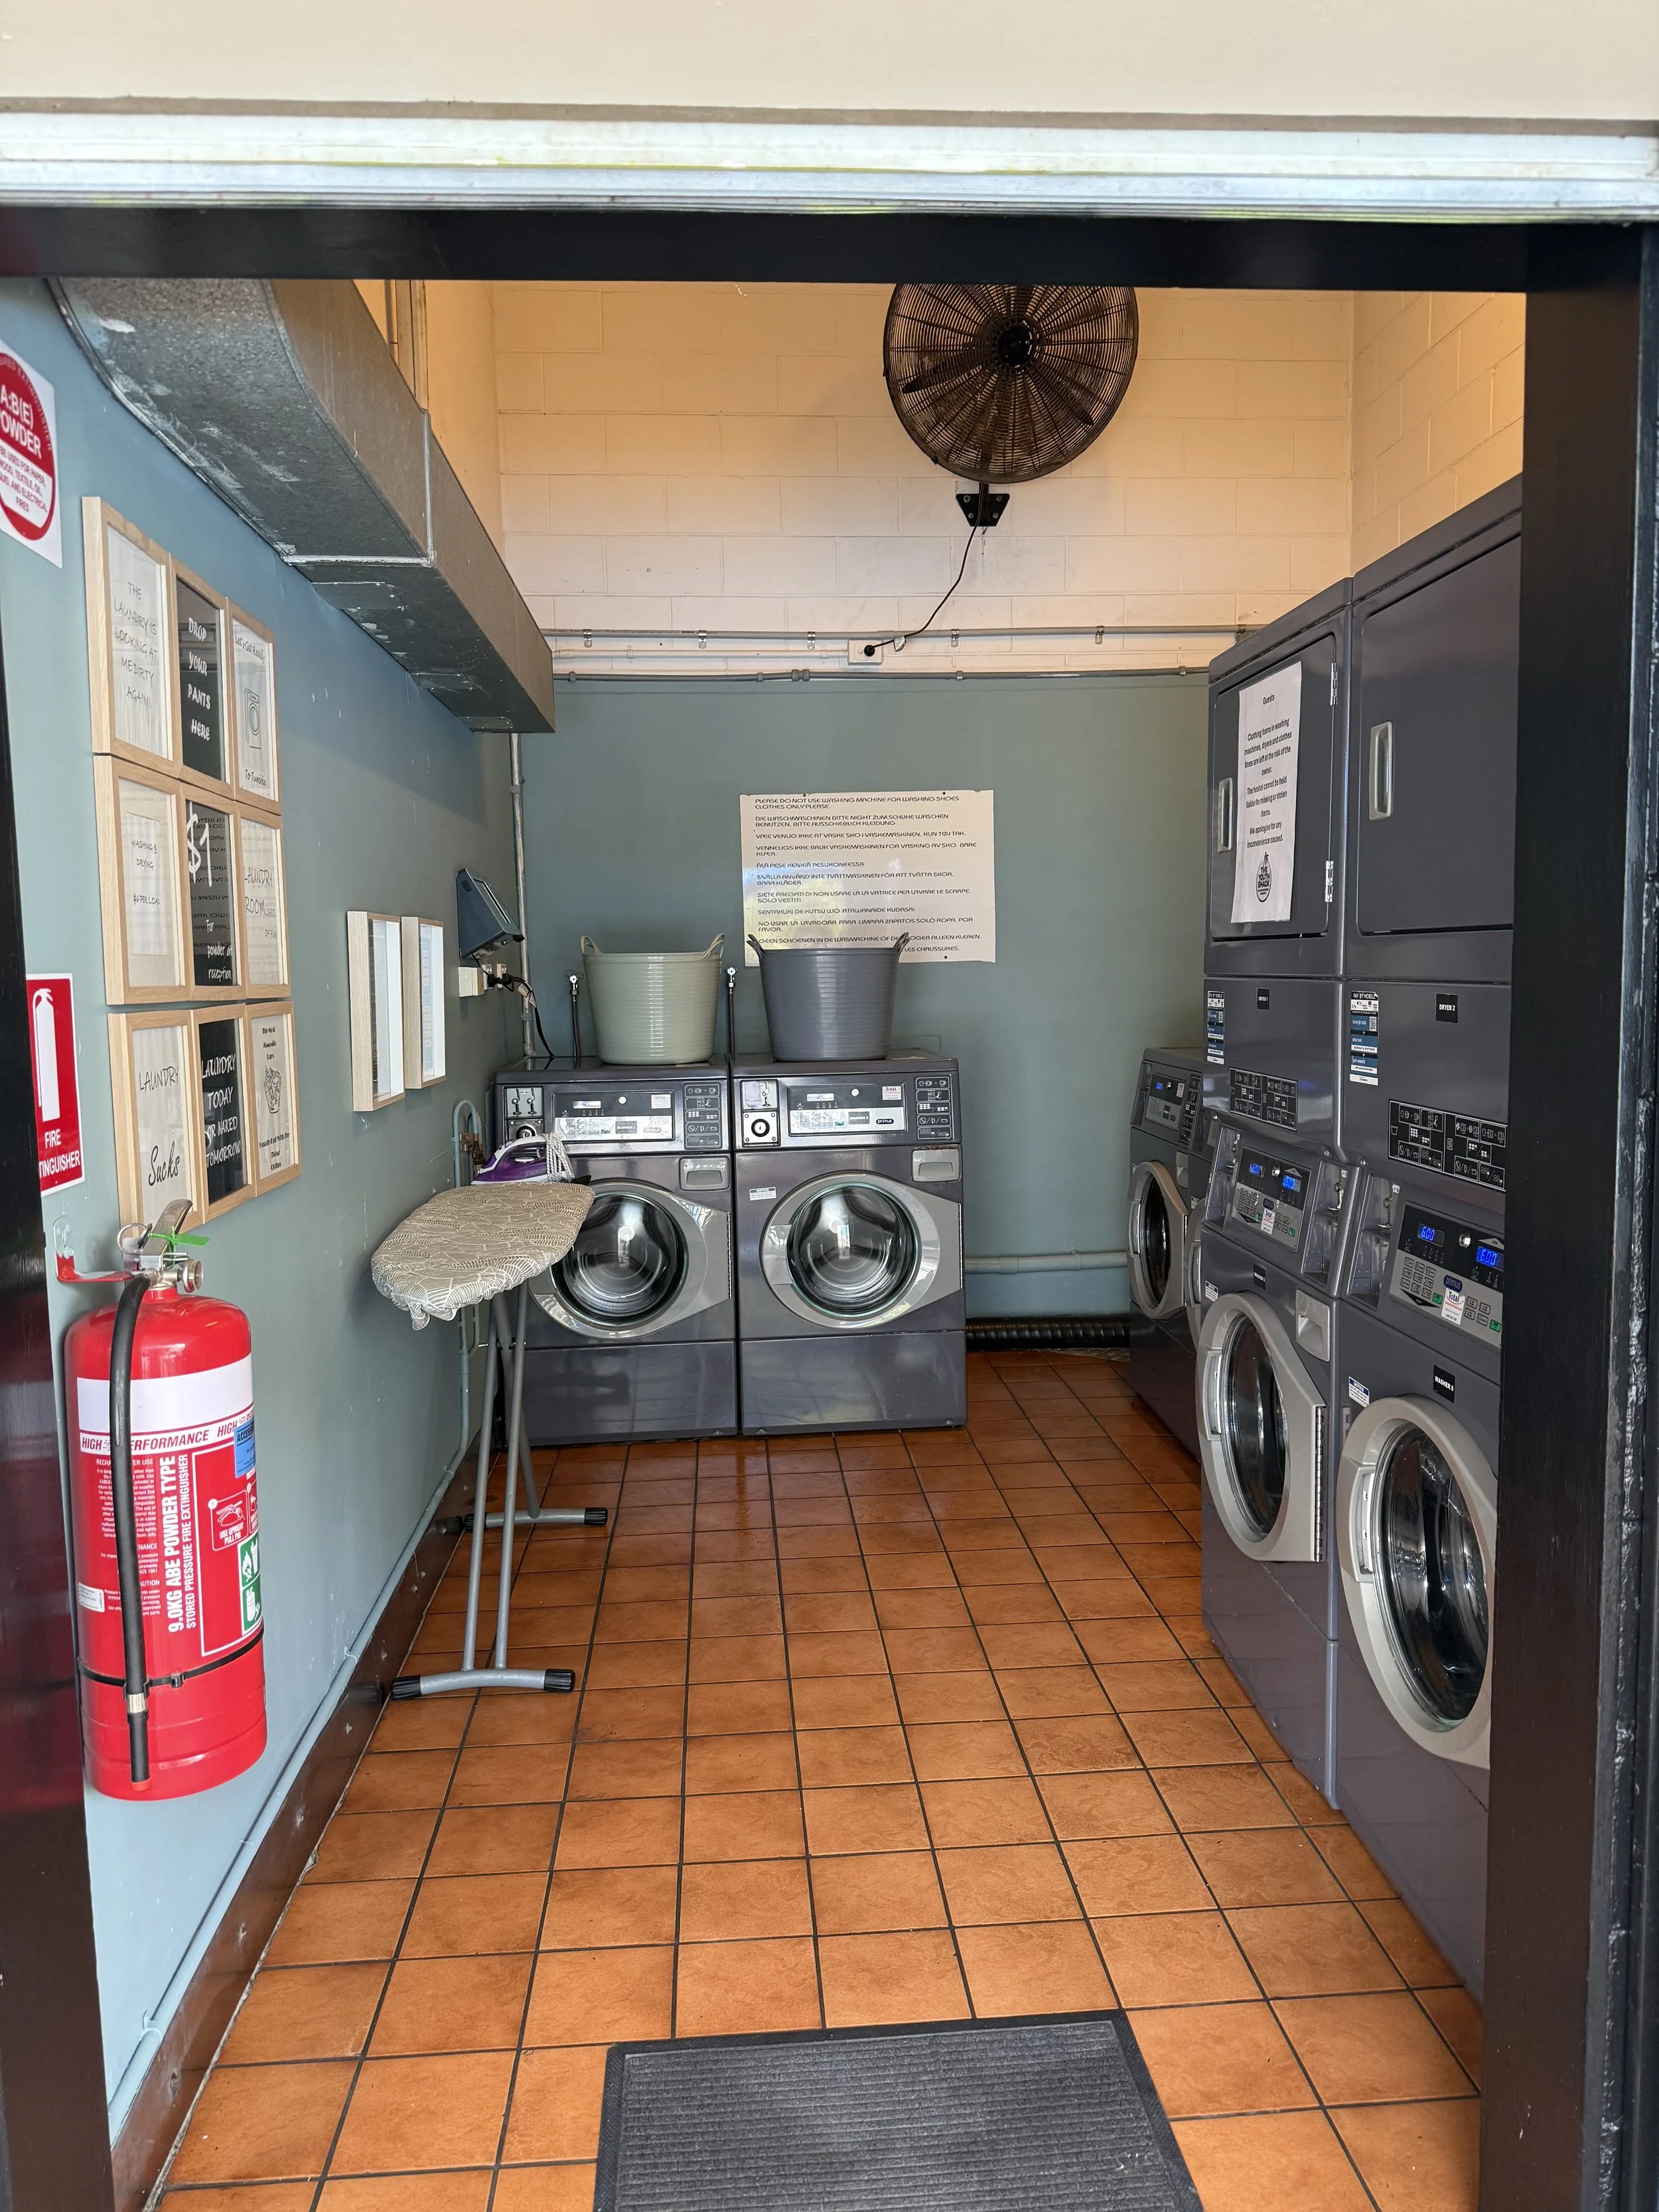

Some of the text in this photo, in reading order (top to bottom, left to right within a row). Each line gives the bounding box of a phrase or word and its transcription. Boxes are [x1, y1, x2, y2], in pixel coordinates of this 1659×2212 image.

[0, 409, 42, 459] OWDER
[128, 581, 142, 600] THE
[114, 598, 157, 635] LAUNDRY IS
[188, 617, 206, 642] DROP
[115, 626, 158, 661] LOOKING AT
[121, 657, 154, 690] ME DIRTY
[188, 651, 207, 676] YOUR
[127, 686, 151, 708] AGAIN!
[188, 684, 210, 710] PANTS
[1263, 695, 1274, 705] Guests
[191, 719, 210, 741] HERE
[1248, 729, 1262, 741] Clothing
[1262, 727, 1271, 736] items
[1275, 718, 1289, 729] washing
[1244, 744, 1262, 755] machines,
[1262, 741, 1272, 749] dryers
[1279, 732, 1292, 743] clothes
[246, 770, 251, 780] To
[1254, 784, 1263, 793] hostel
[1263, 780, 1274, 790] cannot
[1260, 795, 1272, 804] missing
[1277, 790, 1287, 799] stolen
[1256, 823, 1270, 835] apologise
[186, 801, 212, 887] $1
[1248, 838, 1269, 848] inconvenience
[244, 865, 273, 887] LAUNDRY
[245, 897, 265, 915] ROOM
[208, 942, 225, 958] powder
[208, 966, 232, 982] reception
[202, 1053, 236, 1079] LAUNDRY
[139, 1065, 179, 1093] LAUNDRY
[208, 1086, 233, 1110] TODAY
[44, 1128, 61, 1149] FIRE
[206, 1116, 238, 1140] OR NAKED
[38, 1150, 80, 1179] TINGUISHER
[149, 1141, 180, 1186] Sucks
[206, 1140, 241, 1167] TOMORROW
[1421, 1226, 1435, 1241] 6.00
[1480, 1250, 1497, 1266] 6.00
[1446, 1277, 1461, 1289] primus
[1449, 1291, 1459, 1303] Total
[1435, 1375, 1451, 1391] WASHER
[82, 1438, 102, 1451] HIGH
[131, 1430, 209, 1451] ERFORMANCE
[218, 1420, 238, 1438] HIGH
[160, 1456, 184, 1633] 9.0KG ABE POWDER TYPE
[178, 1454, 196, 1629] STORED PRESSURE FIRE EXTINGUISHER
